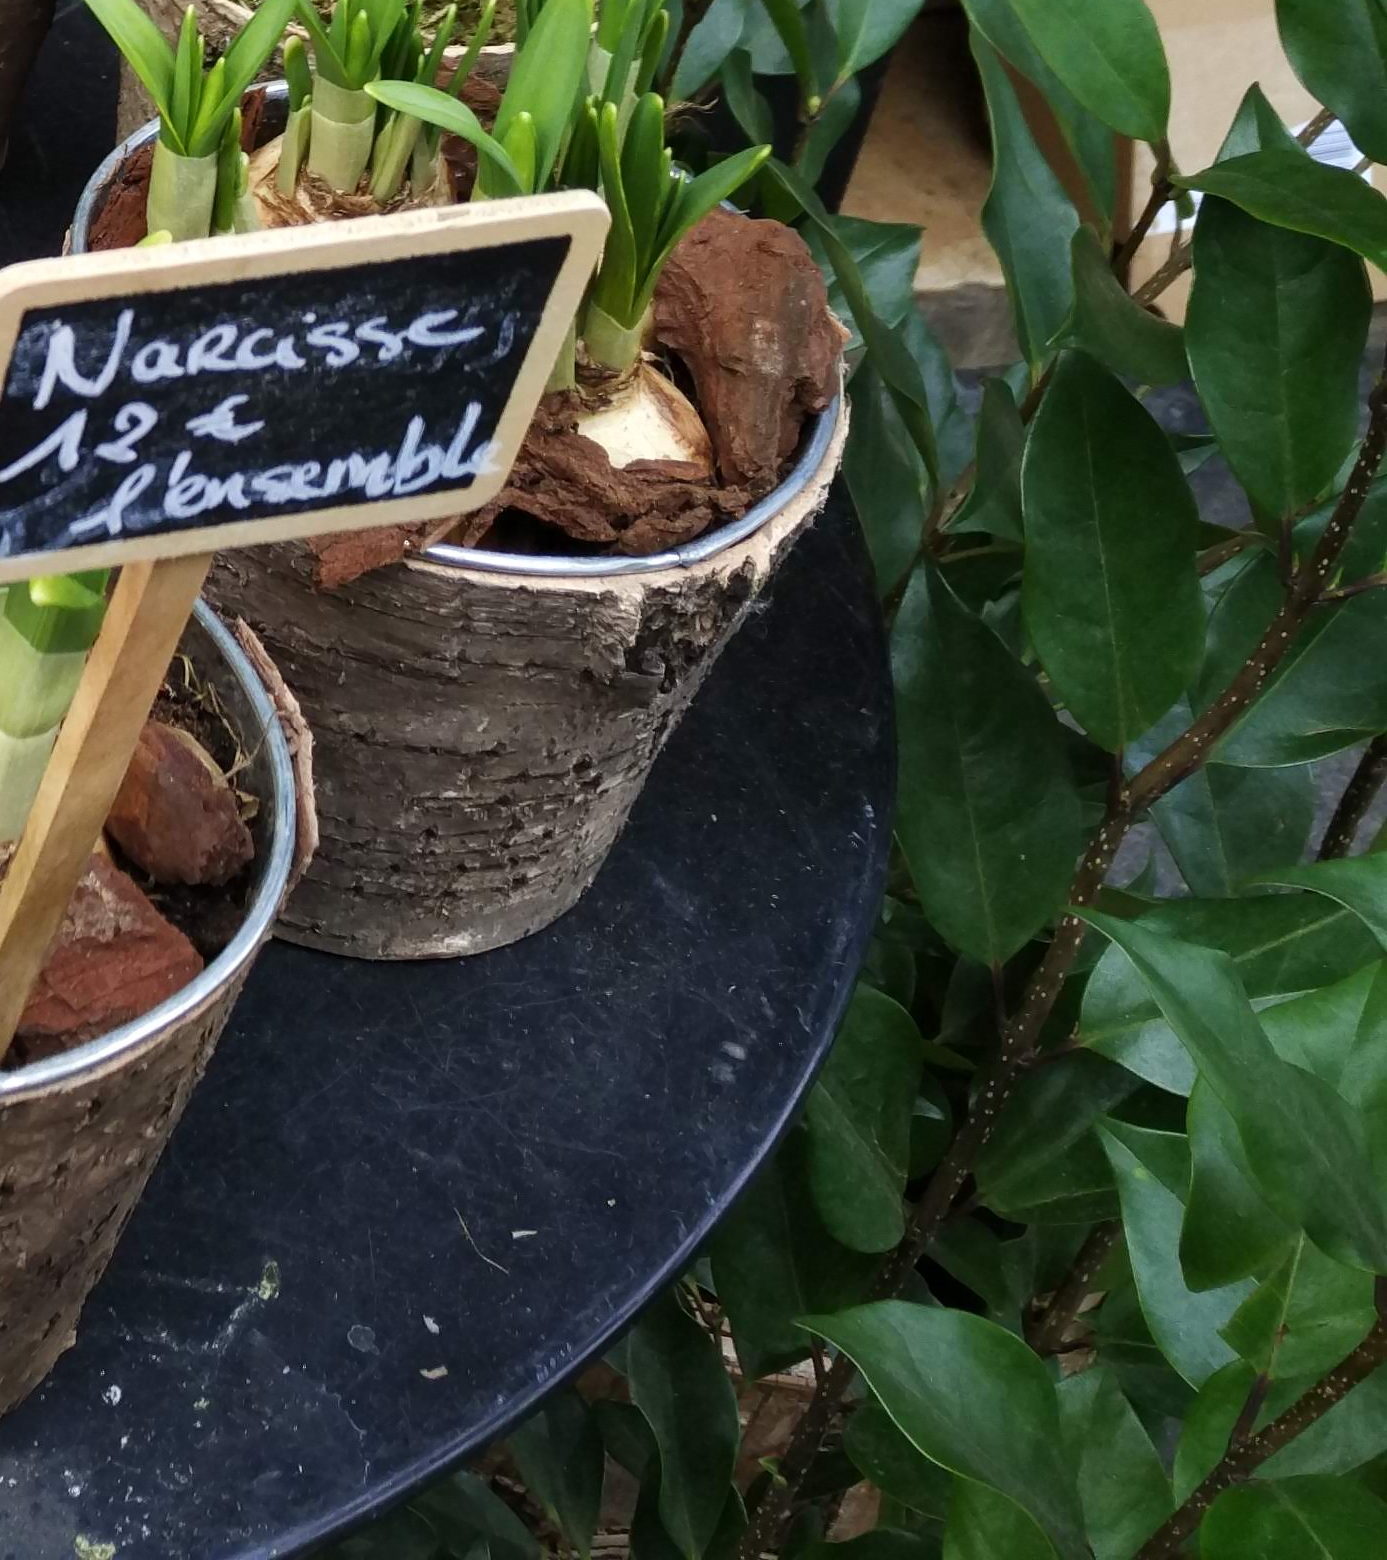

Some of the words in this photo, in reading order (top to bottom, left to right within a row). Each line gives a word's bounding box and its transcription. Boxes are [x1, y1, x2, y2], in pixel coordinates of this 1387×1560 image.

[33, 309, 485, 410] Narcisse
[185, 394, 264, 441] €
[69, 401, 502, 536] l'ensemble
